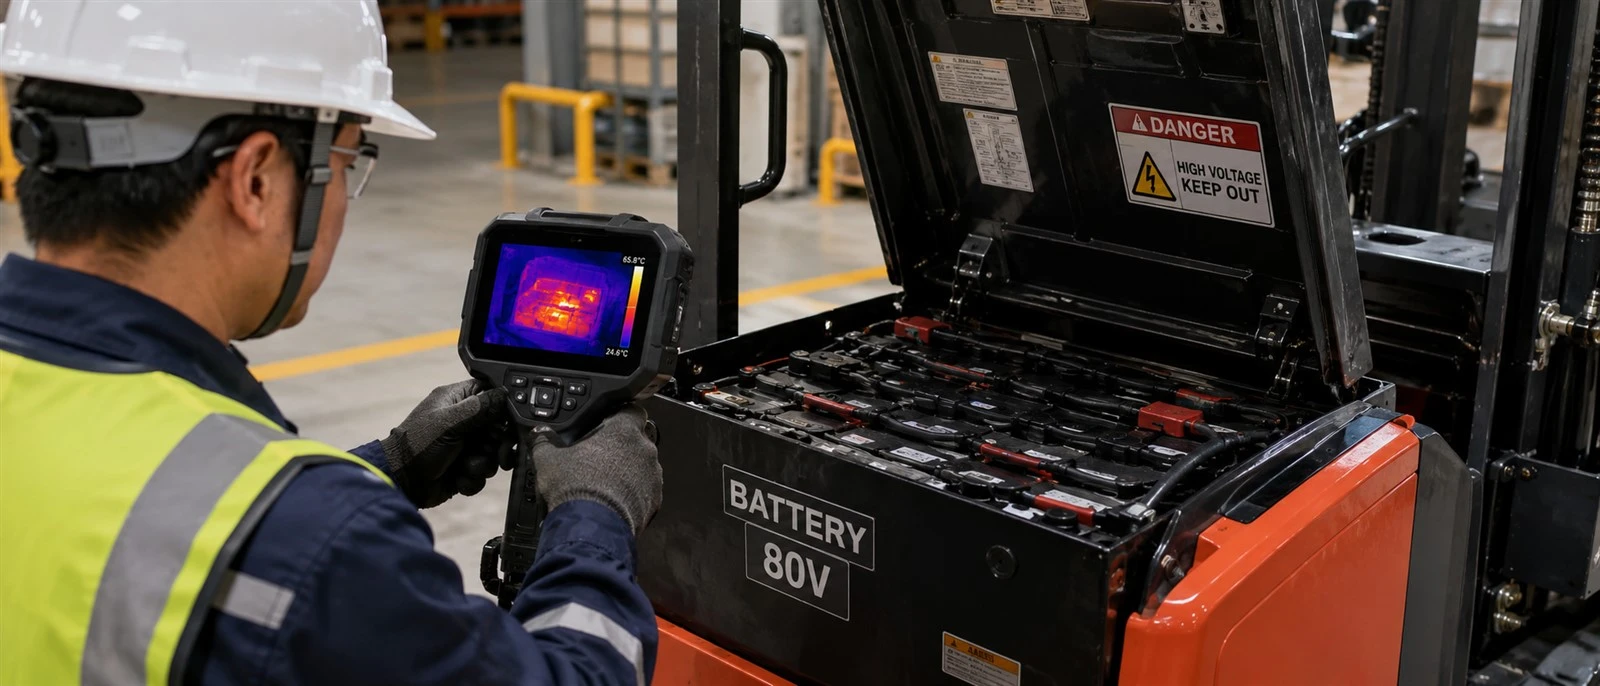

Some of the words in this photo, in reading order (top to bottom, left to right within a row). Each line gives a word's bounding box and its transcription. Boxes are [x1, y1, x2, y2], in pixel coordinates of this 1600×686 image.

[1151, 116, 1236, 145] DANGER
[1177, 160, 1206, 178] HIGH
[1208, 165, 1262, 186] VOLTAGE
[1181, 177, 1222, 197] KEEP
[1225, 184, 1260, 204] OUT
[622, 256, 646, 264] 65.8°C
[606, 348, 628, 358] 24.6°C
[729, 479, 867, 555] BATTERY
[763, 541, 831, 599] 80V
